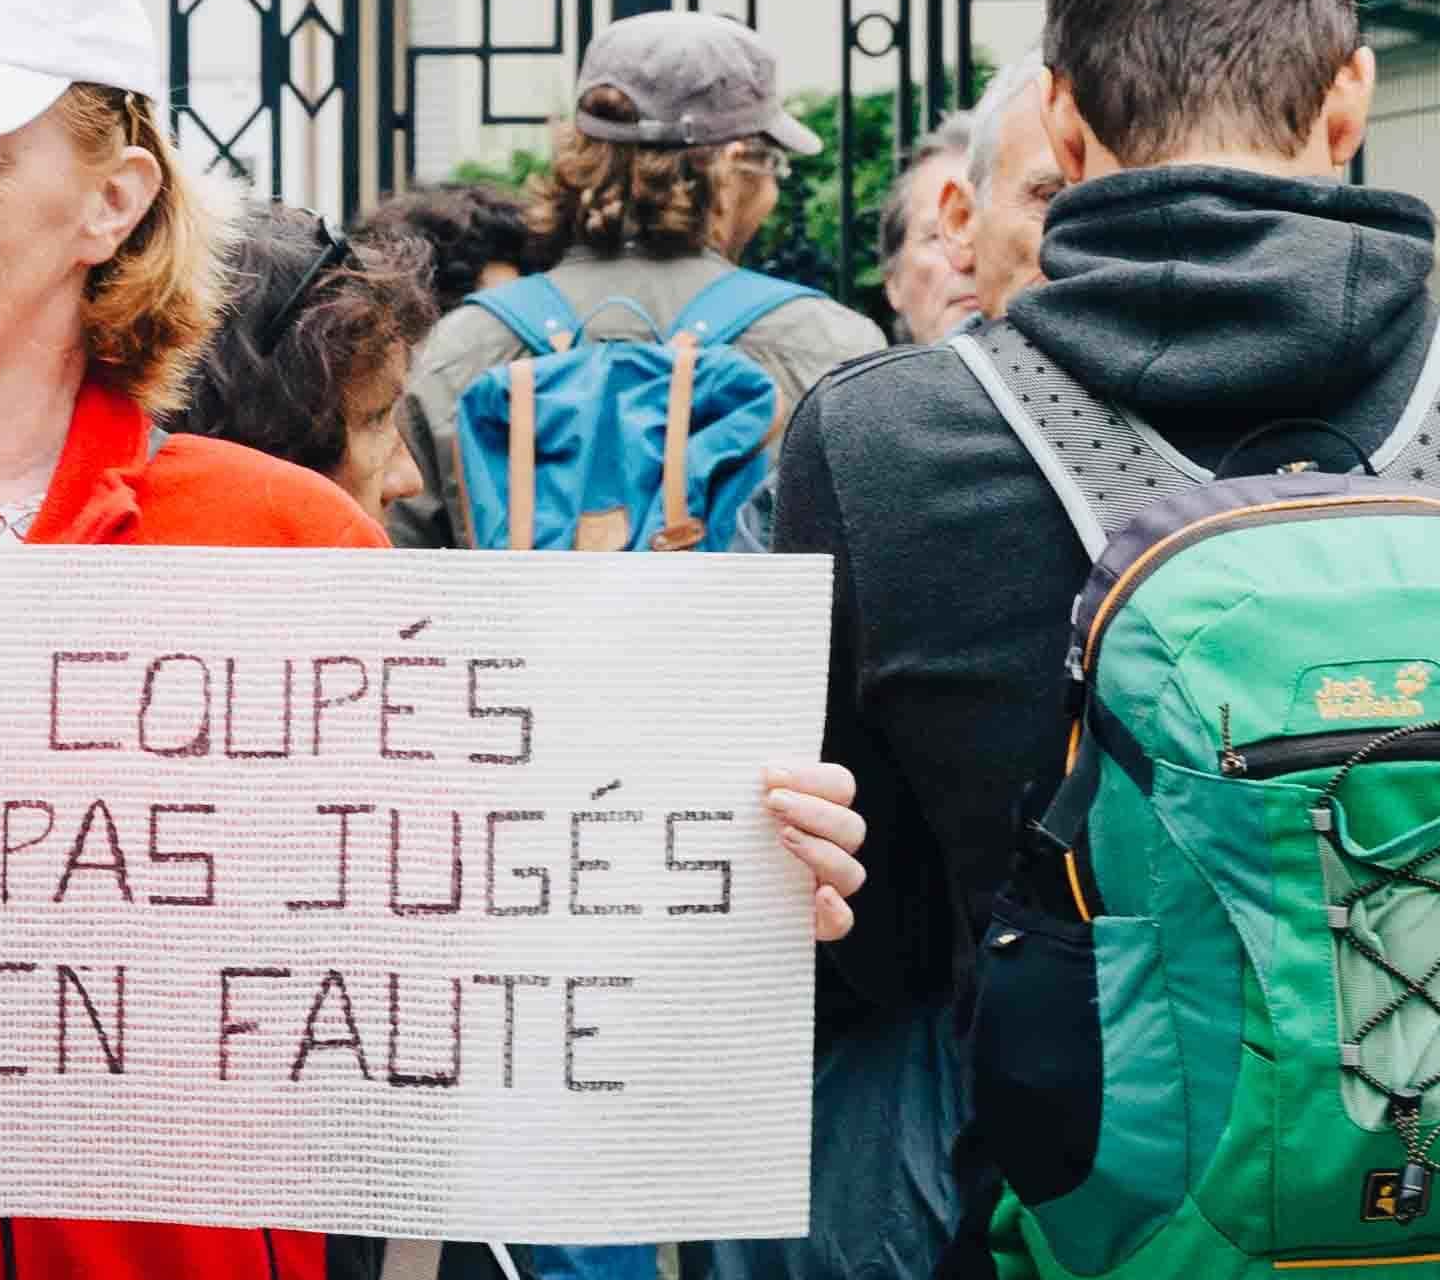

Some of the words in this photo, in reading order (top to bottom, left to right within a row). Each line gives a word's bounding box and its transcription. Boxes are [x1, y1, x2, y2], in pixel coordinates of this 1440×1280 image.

[49, 618, 533, 764] COUPÉS
[1316, 675, 1376, 701] Jack
[1317, 695, 1425, 719] Wolfskin
[1, 799, 216, 907] PAS
[286, 780, 734, 916] JUGÉS
[219, 966, 635, 1091] FAUTE
